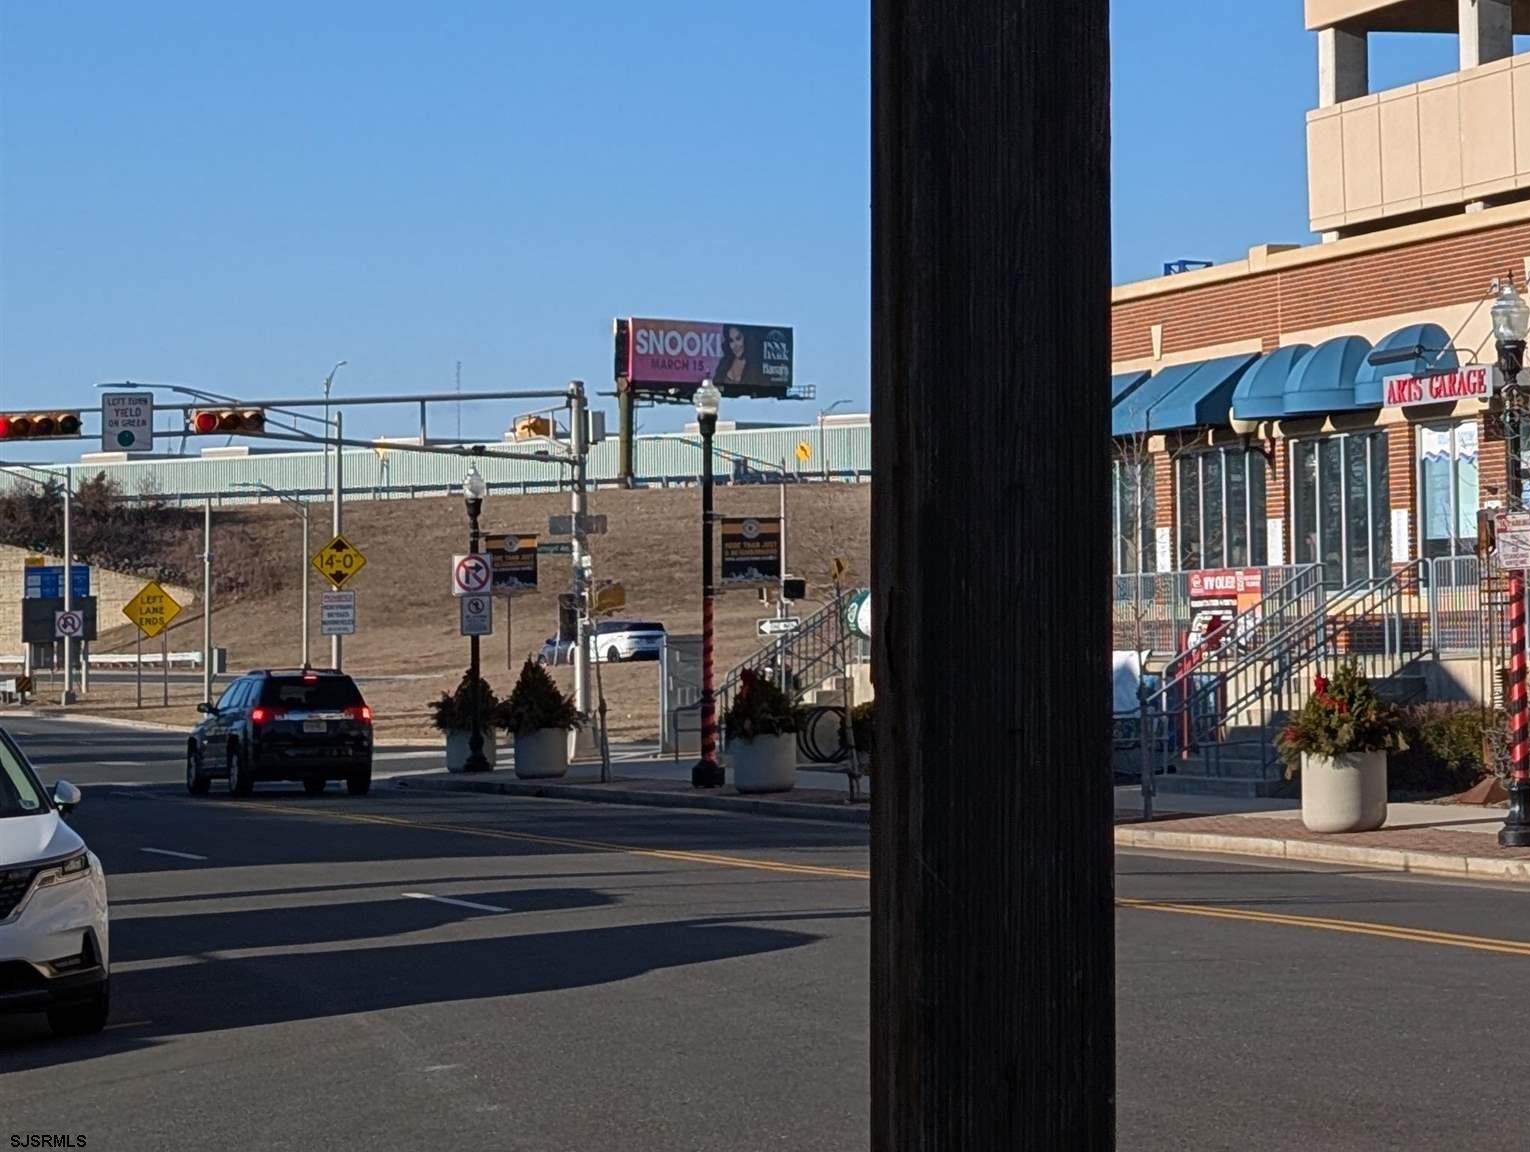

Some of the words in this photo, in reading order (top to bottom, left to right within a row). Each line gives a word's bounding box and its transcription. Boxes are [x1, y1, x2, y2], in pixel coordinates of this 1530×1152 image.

[635, 328, 723, 359] SNOOKI
[651, 358, 690, 371] MARCH
[692, 360, 705, 372] 15
[1387, 377, 1424, 405] ARTS
[1429, 368, 1487, 400] GARAGE
[113, 407, 142, 418] YIELD
[140, 594, 164, 605] LEFT
[139, 605, 165, 616] LANE
[139, 616, 165, 627] ENDS
